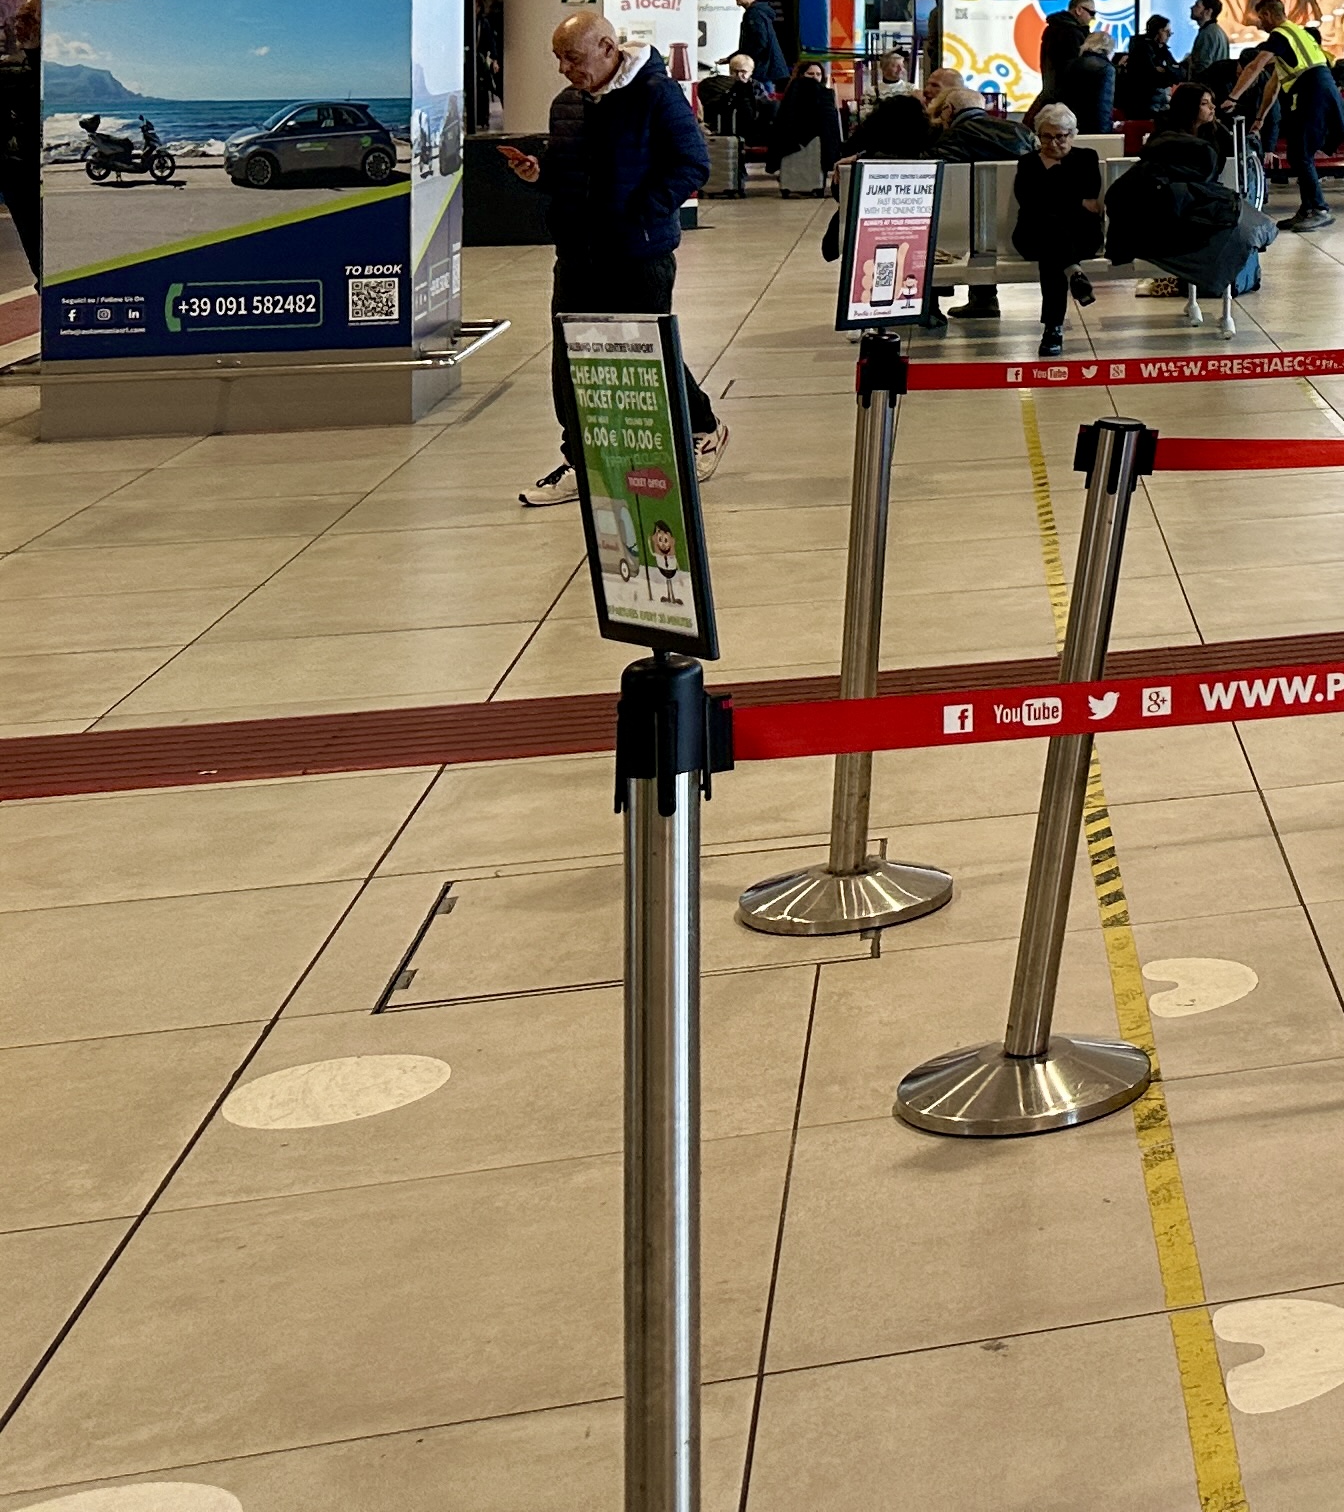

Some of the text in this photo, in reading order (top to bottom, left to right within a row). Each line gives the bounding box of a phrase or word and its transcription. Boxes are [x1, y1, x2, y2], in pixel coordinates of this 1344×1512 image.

[620, 0, 631, 11] a
[866, 184, 912, 196] JUMP THE
[345, 264, 402, 276] TO BOOK
[178, 294, 317, 317] +39 091 582482
[570, 365, 660, 387] CHEAPER AT THE
[575, 389, 658, 411] TICKET OFFICE!
[993, 696, 1063, 727] YouTube
